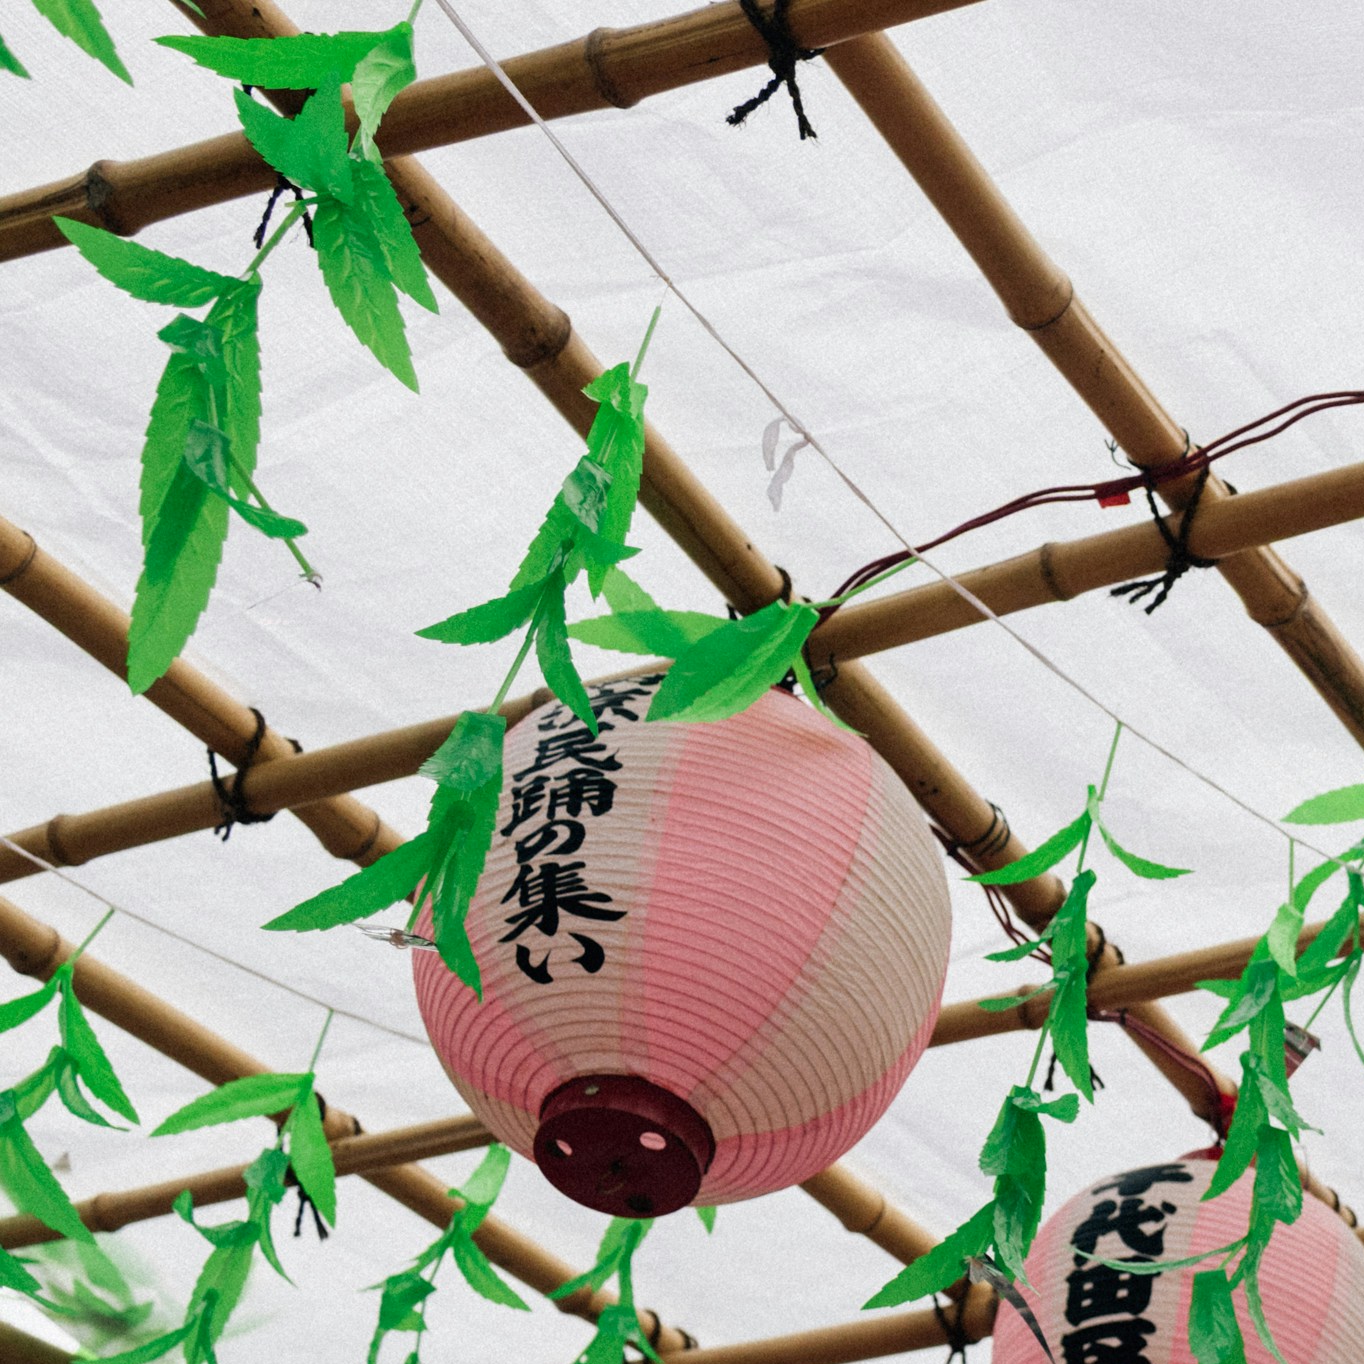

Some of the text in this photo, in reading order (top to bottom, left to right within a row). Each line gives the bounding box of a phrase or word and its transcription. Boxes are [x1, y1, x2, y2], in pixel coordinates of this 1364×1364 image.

[498, 673, 667, 984] 涼民踊の集い
